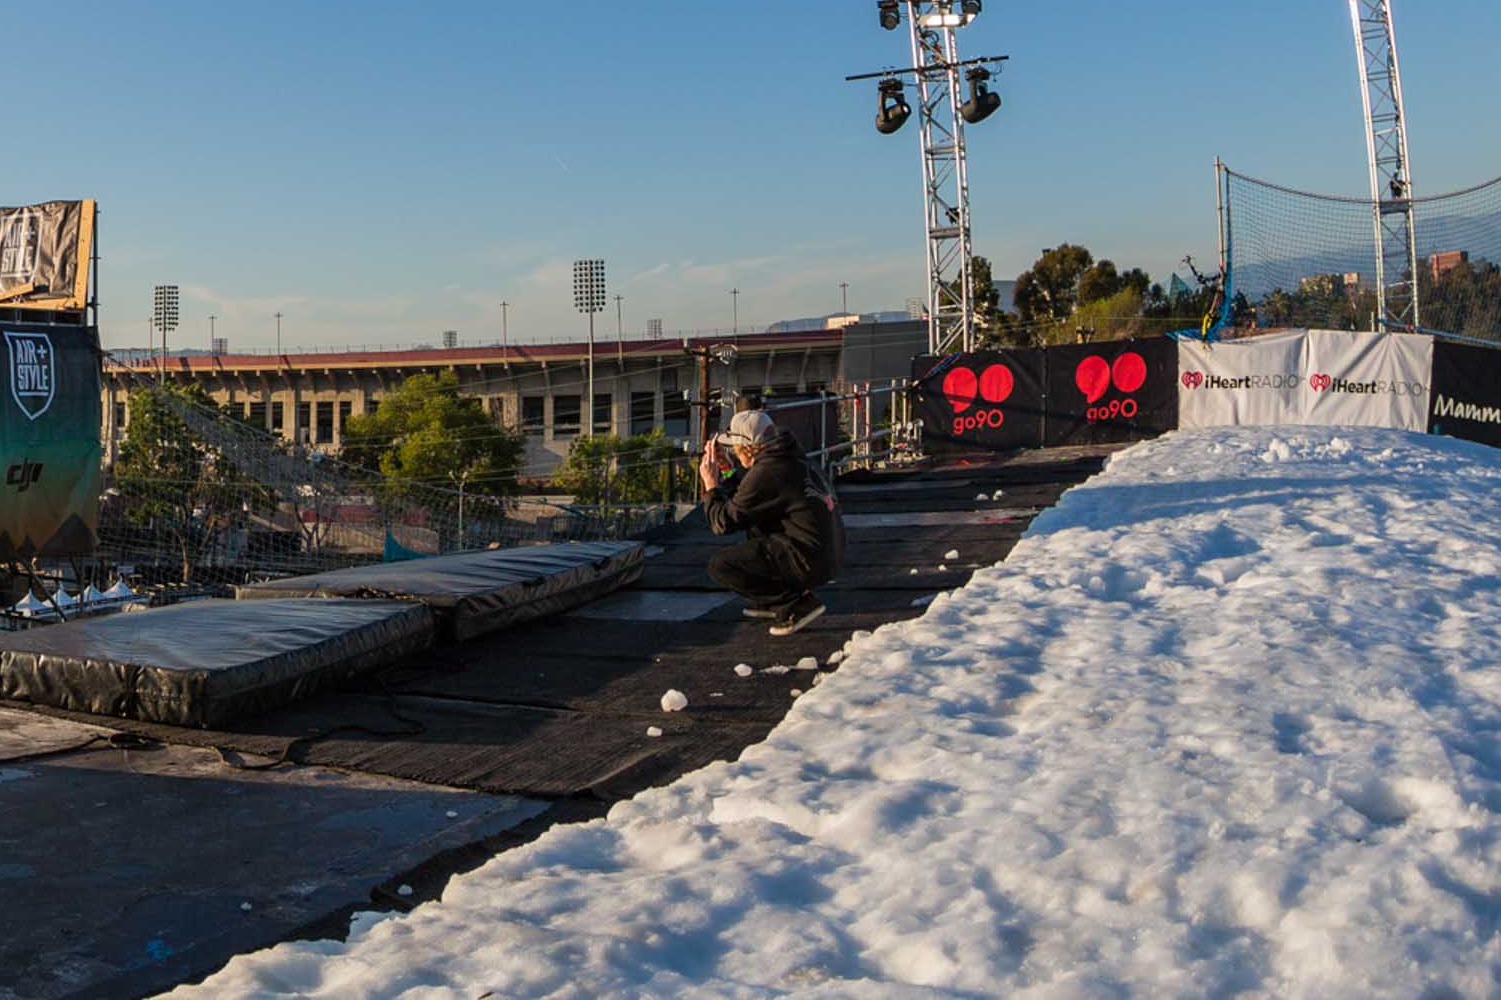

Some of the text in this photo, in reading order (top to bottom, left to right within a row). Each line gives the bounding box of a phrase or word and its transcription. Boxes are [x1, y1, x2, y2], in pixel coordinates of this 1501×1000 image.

[17, 364, 49, 391] STYLE
[1205, 374, 1298, 389] iHeartRADIO
[1332, 375, 1423, 396] iHeartRADIO
[953, 408, 1004, 435] go90
[1086, 398, 1138, 425] go90
